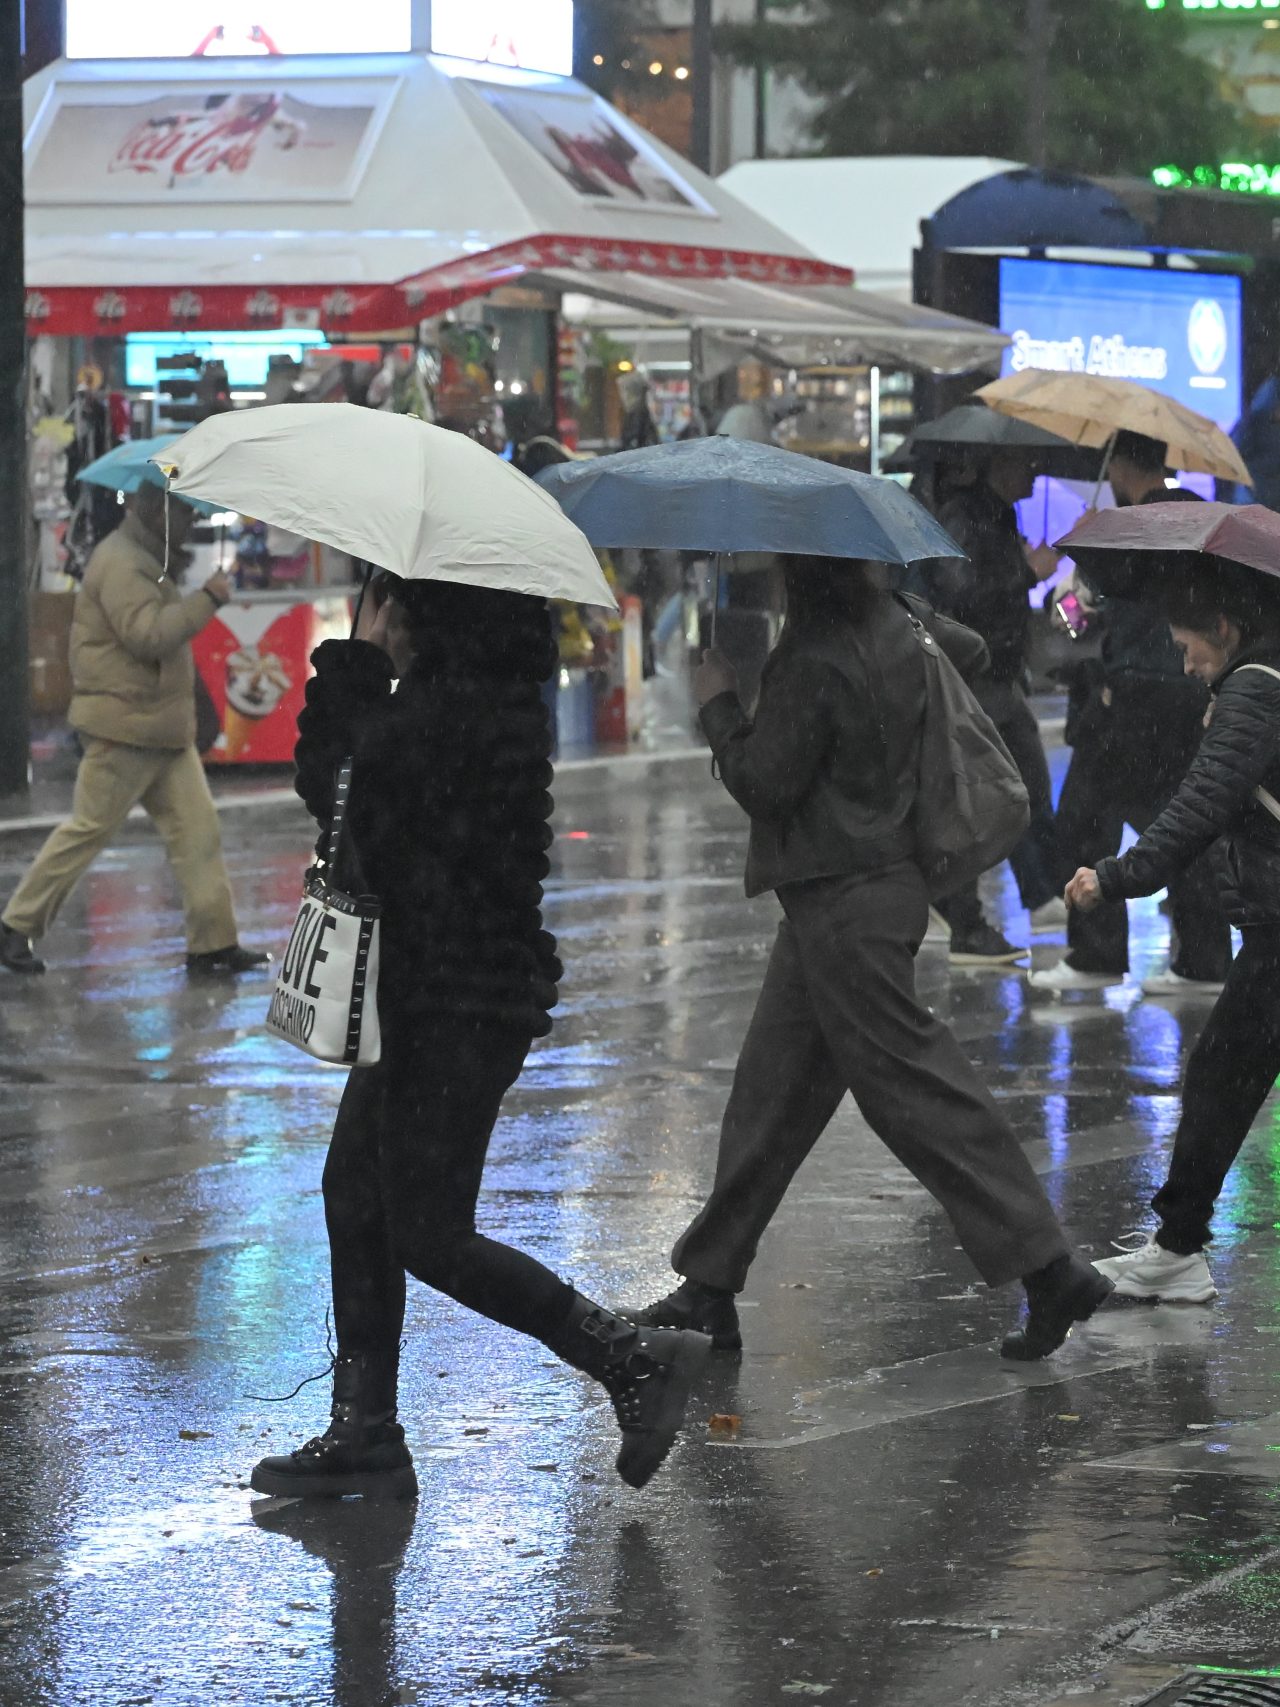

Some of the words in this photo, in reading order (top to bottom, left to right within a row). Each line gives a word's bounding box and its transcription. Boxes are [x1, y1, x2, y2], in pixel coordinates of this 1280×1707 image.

[1011, 330, 1085, 372] Smart
[1086, 334, 1167, 380] Athens
[278, 903, 337, 1000] OVE
[267, 987, 316, 1045] OSCHINO
